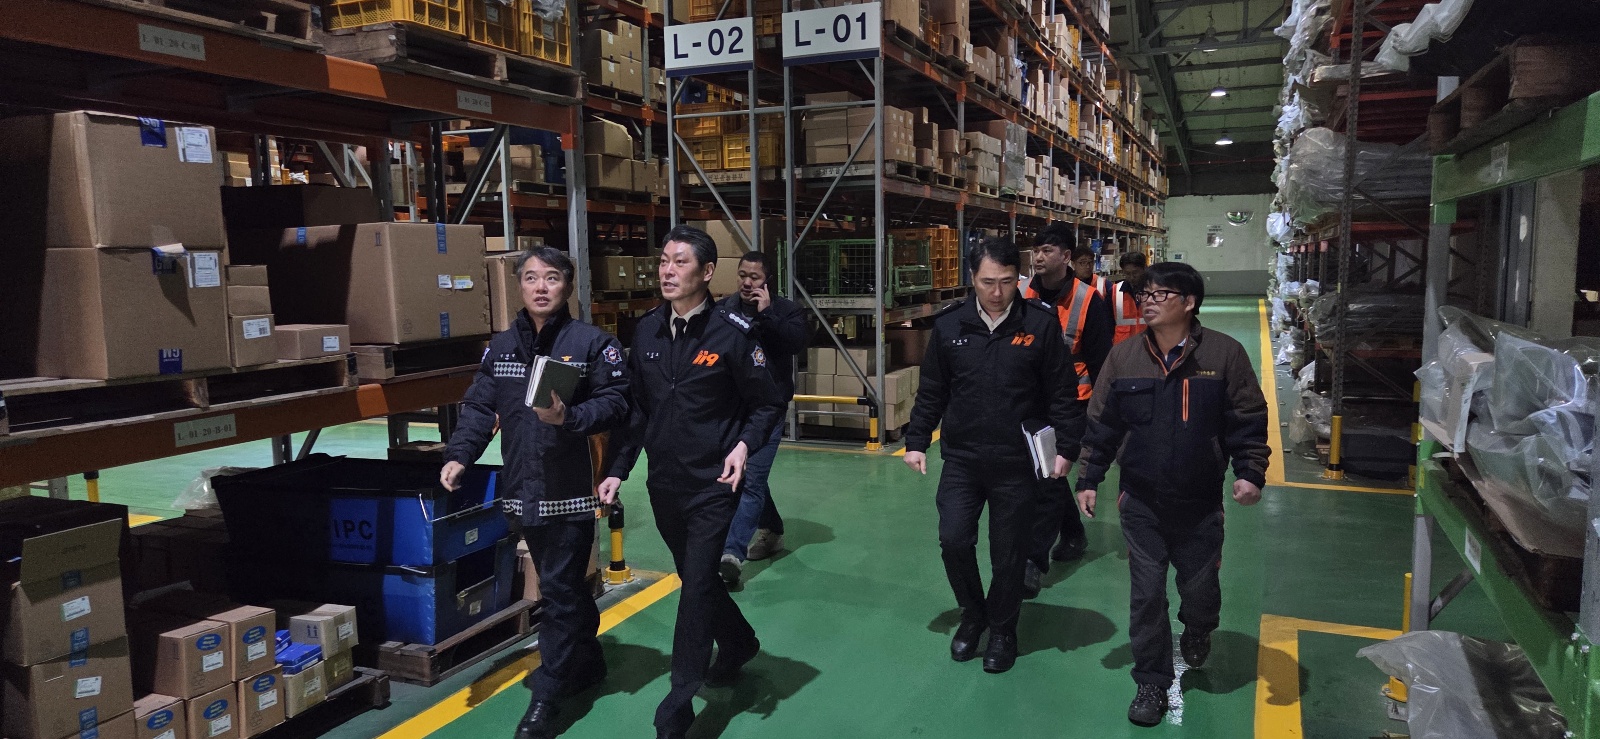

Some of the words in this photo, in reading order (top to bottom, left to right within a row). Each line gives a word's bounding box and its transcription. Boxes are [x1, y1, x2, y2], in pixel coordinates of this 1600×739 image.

[673, 26, 744, 59] L-02
[795, 12, 867, 47] L-01
[692, 352, 719, 366] 119
